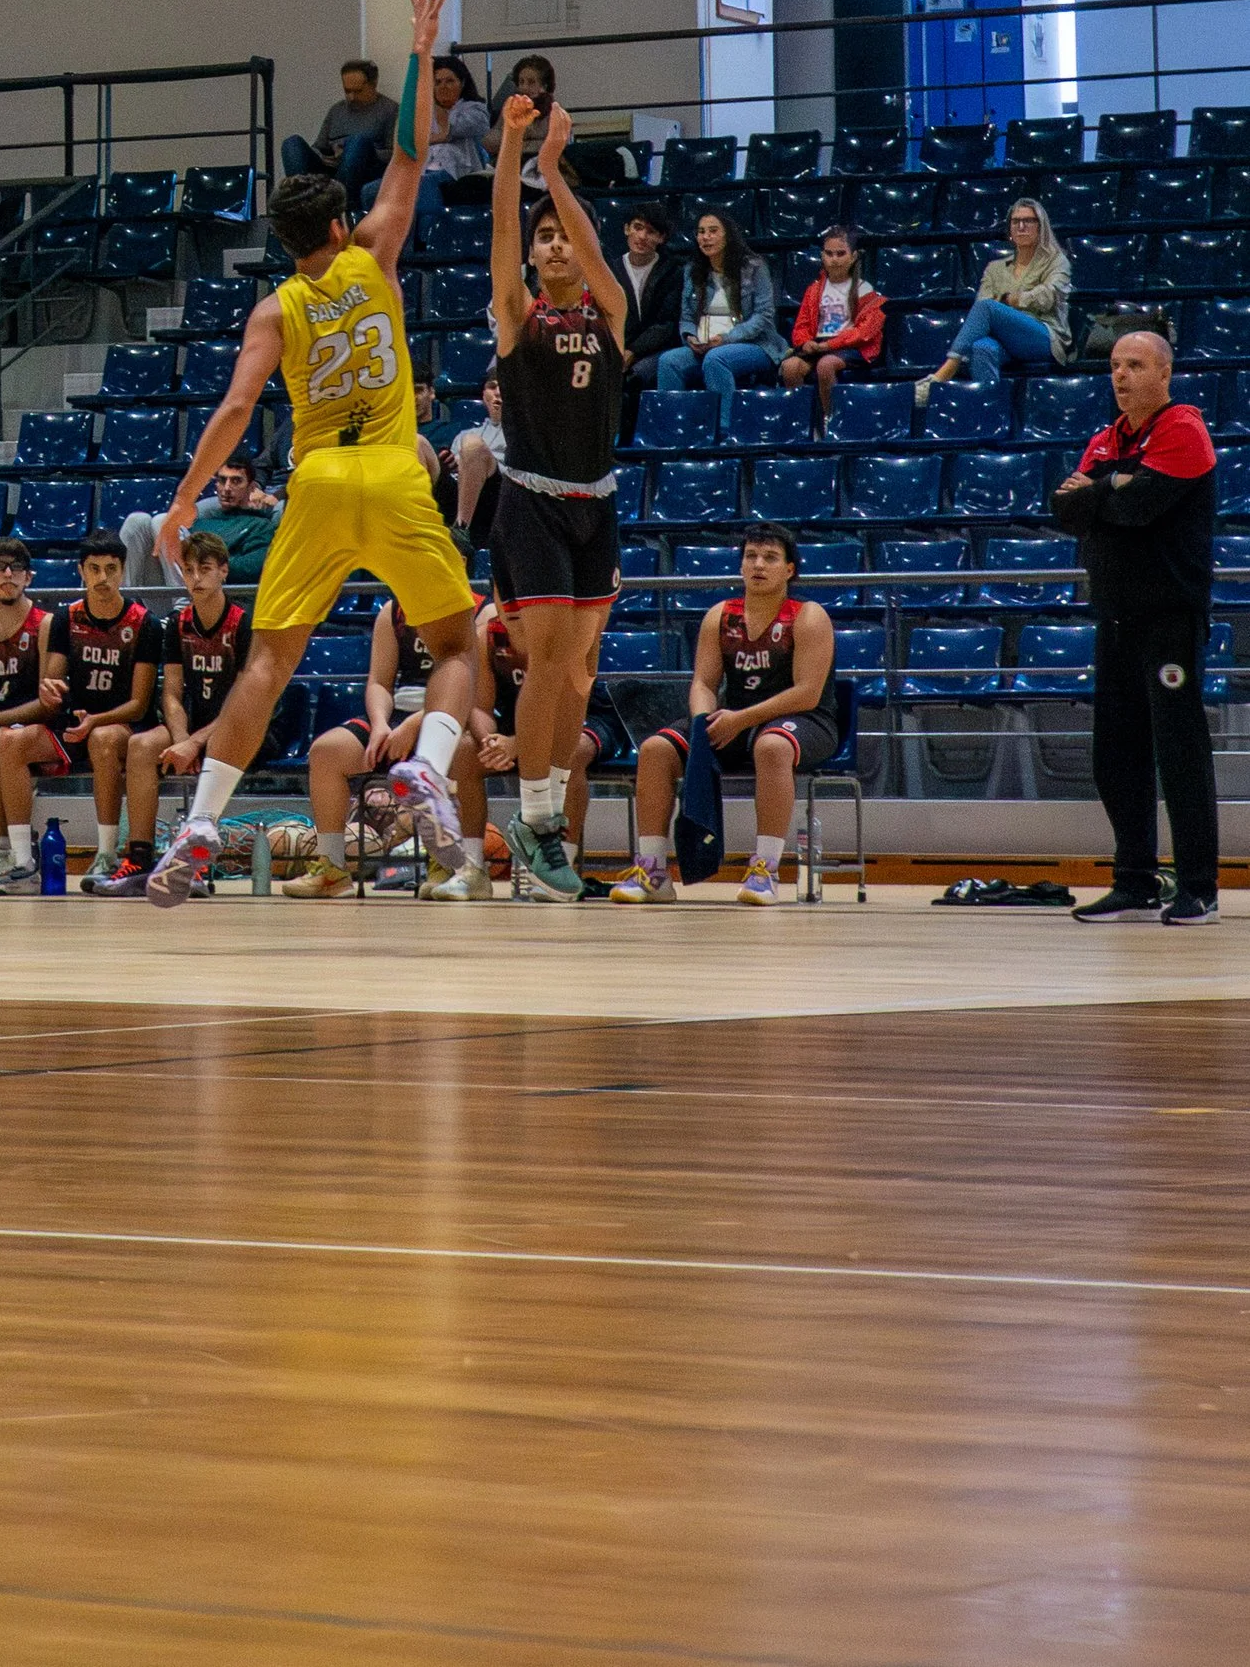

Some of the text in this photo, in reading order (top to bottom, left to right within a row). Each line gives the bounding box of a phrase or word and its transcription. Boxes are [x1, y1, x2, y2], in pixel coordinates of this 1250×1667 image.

[307, 311, 399, 405] 23
[571, 360, 592, 389] 8
[82, 645, 120, 666] CDJR
[85, 669, 114, 691] 16
[202, 677, 214, 700] 5
[744, 675, 762, 690] 9
